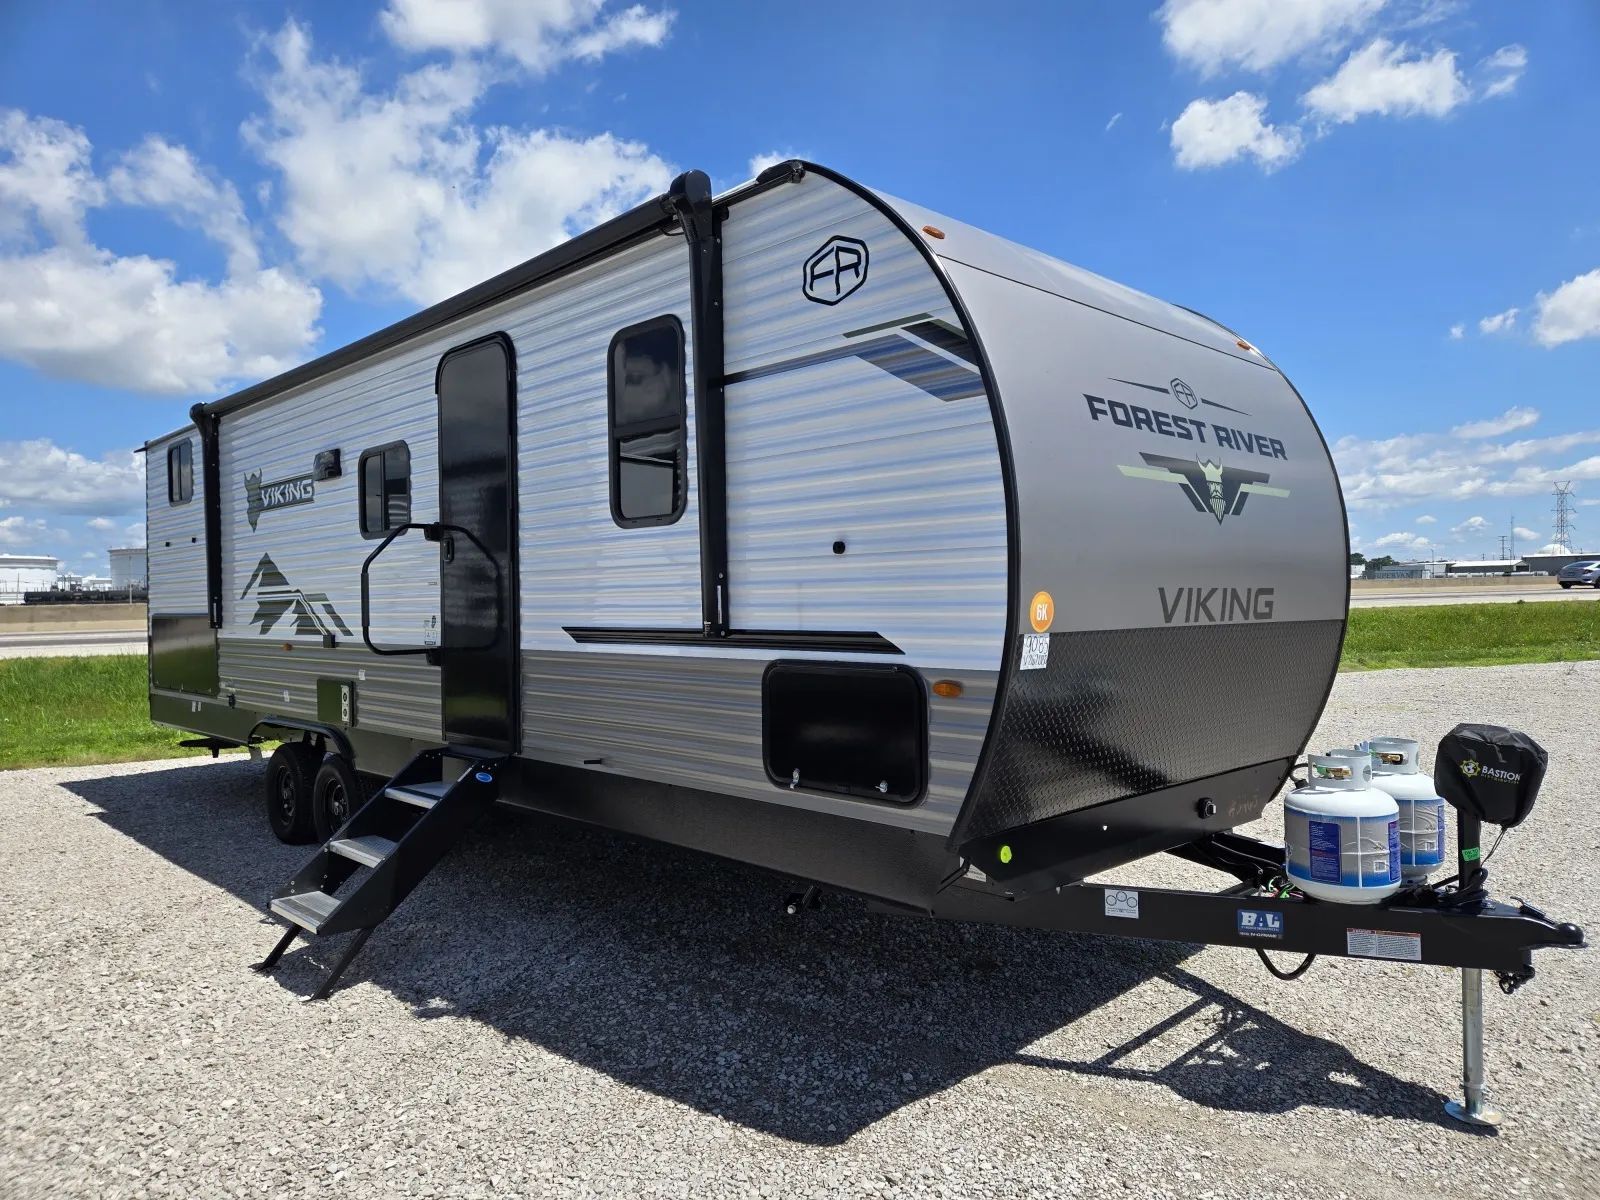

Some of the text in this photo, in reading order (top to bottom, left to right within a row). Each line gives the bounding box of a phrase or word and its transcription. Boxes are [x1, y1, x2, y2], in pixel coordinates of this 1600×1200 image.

[1083, 393, 1288, 461] FOREST RIVER
[261, 479, 313, 507] VIKING
[1158, 587, 1275, 624] VIKING
[1482, 765, 1521, 781] BASTION
[1241, 911, 1280, 928] BAL
